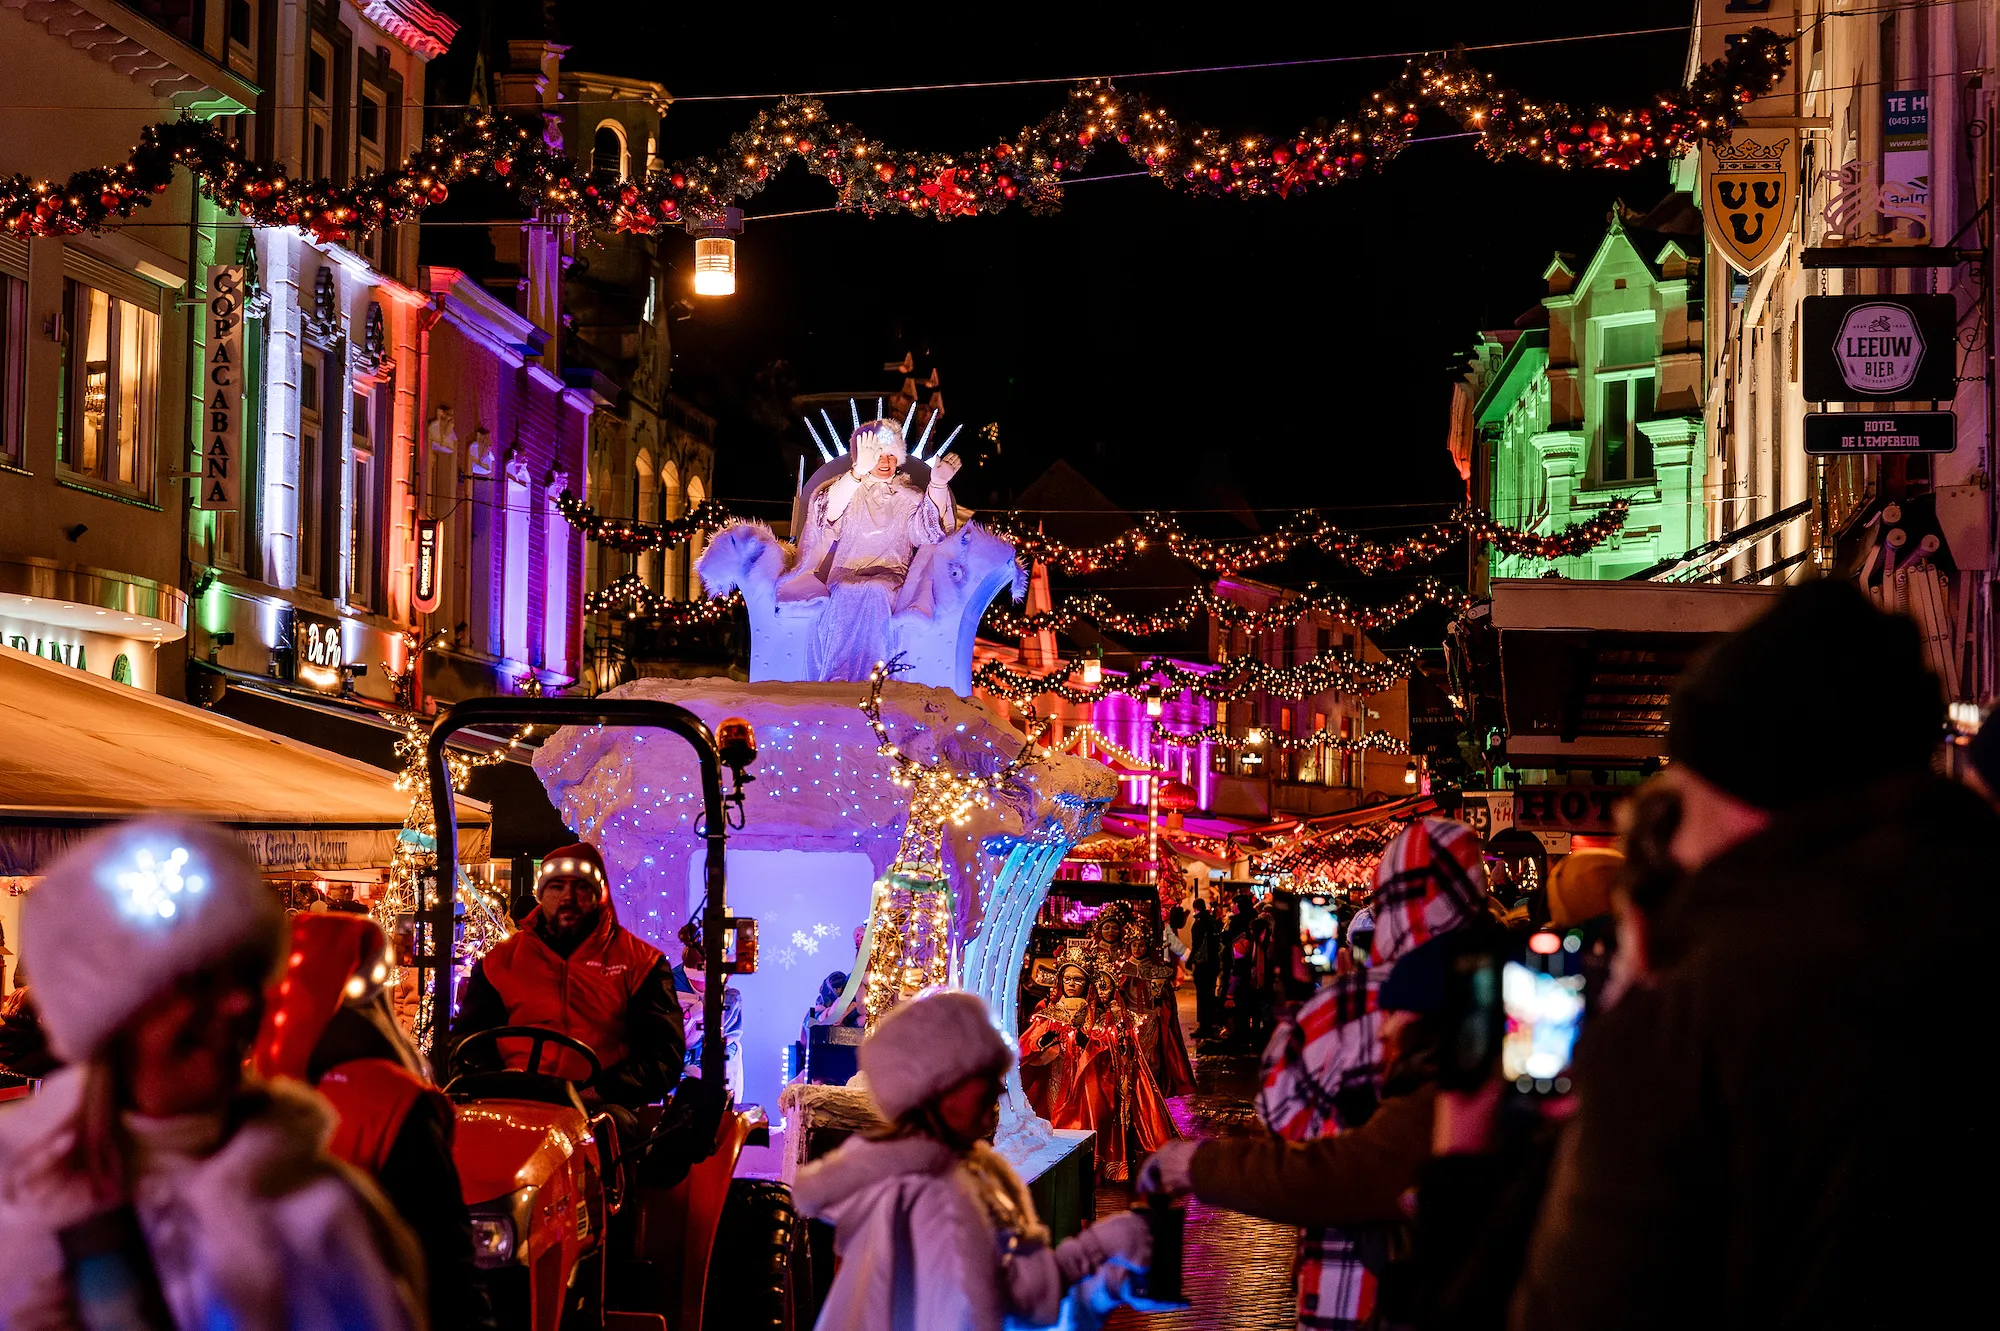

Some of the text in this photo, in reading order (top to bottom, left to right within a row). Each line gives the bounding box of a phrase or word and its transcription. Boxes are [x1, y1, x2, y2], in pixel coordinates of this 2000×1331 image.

[1888, 98, 1906, 112] TE
[1889, 115, 1926, 126] (045) 575
[1846, 336, 1912, 357] LEEUW
[1865, 361, 1894, 377] BIER
[207, 273, 234, 501] COPACABANA
[1864, 420, 1897, 432] HOTEL
[1842, 435, 1920, 448] DE L'EMPEREUR
[308, 623, 324, 665] Da
